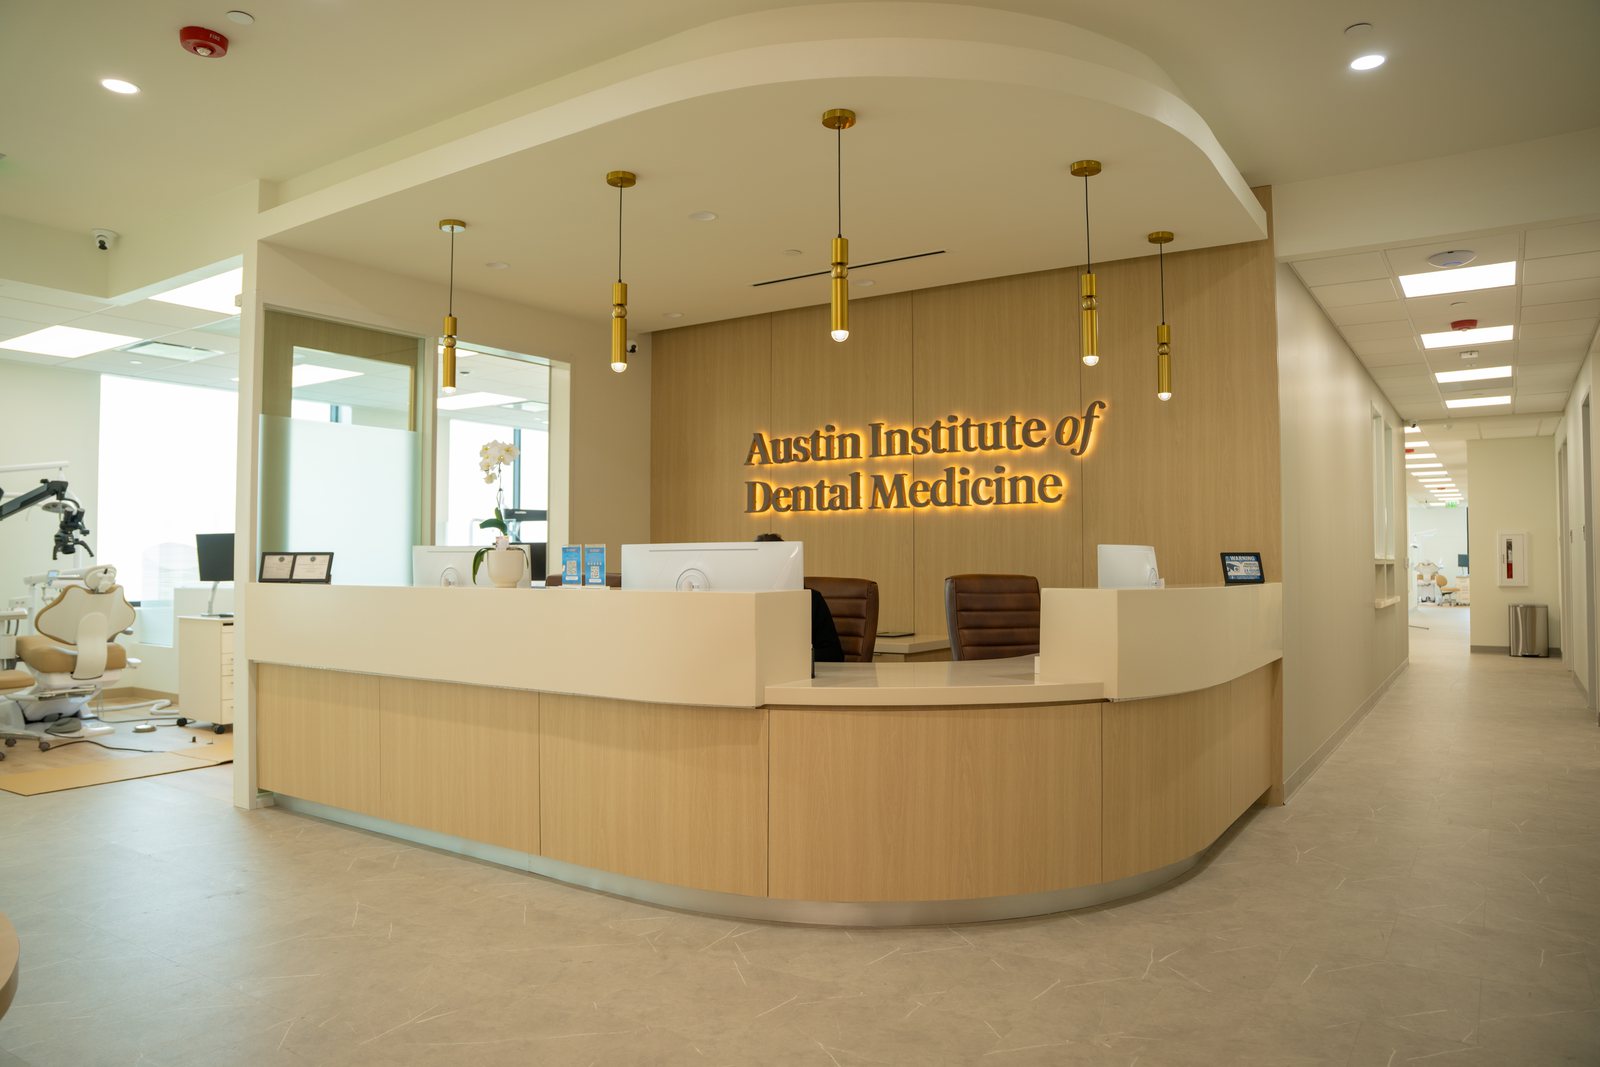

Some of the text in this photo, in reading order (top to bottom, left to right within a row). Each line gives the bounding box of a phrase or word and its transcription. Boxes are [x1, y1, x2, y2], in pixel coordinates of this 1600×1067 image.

[744, 400, 1106, 465] Austin Institute of
[744, 465, 1063, 513] Dental Medicine
